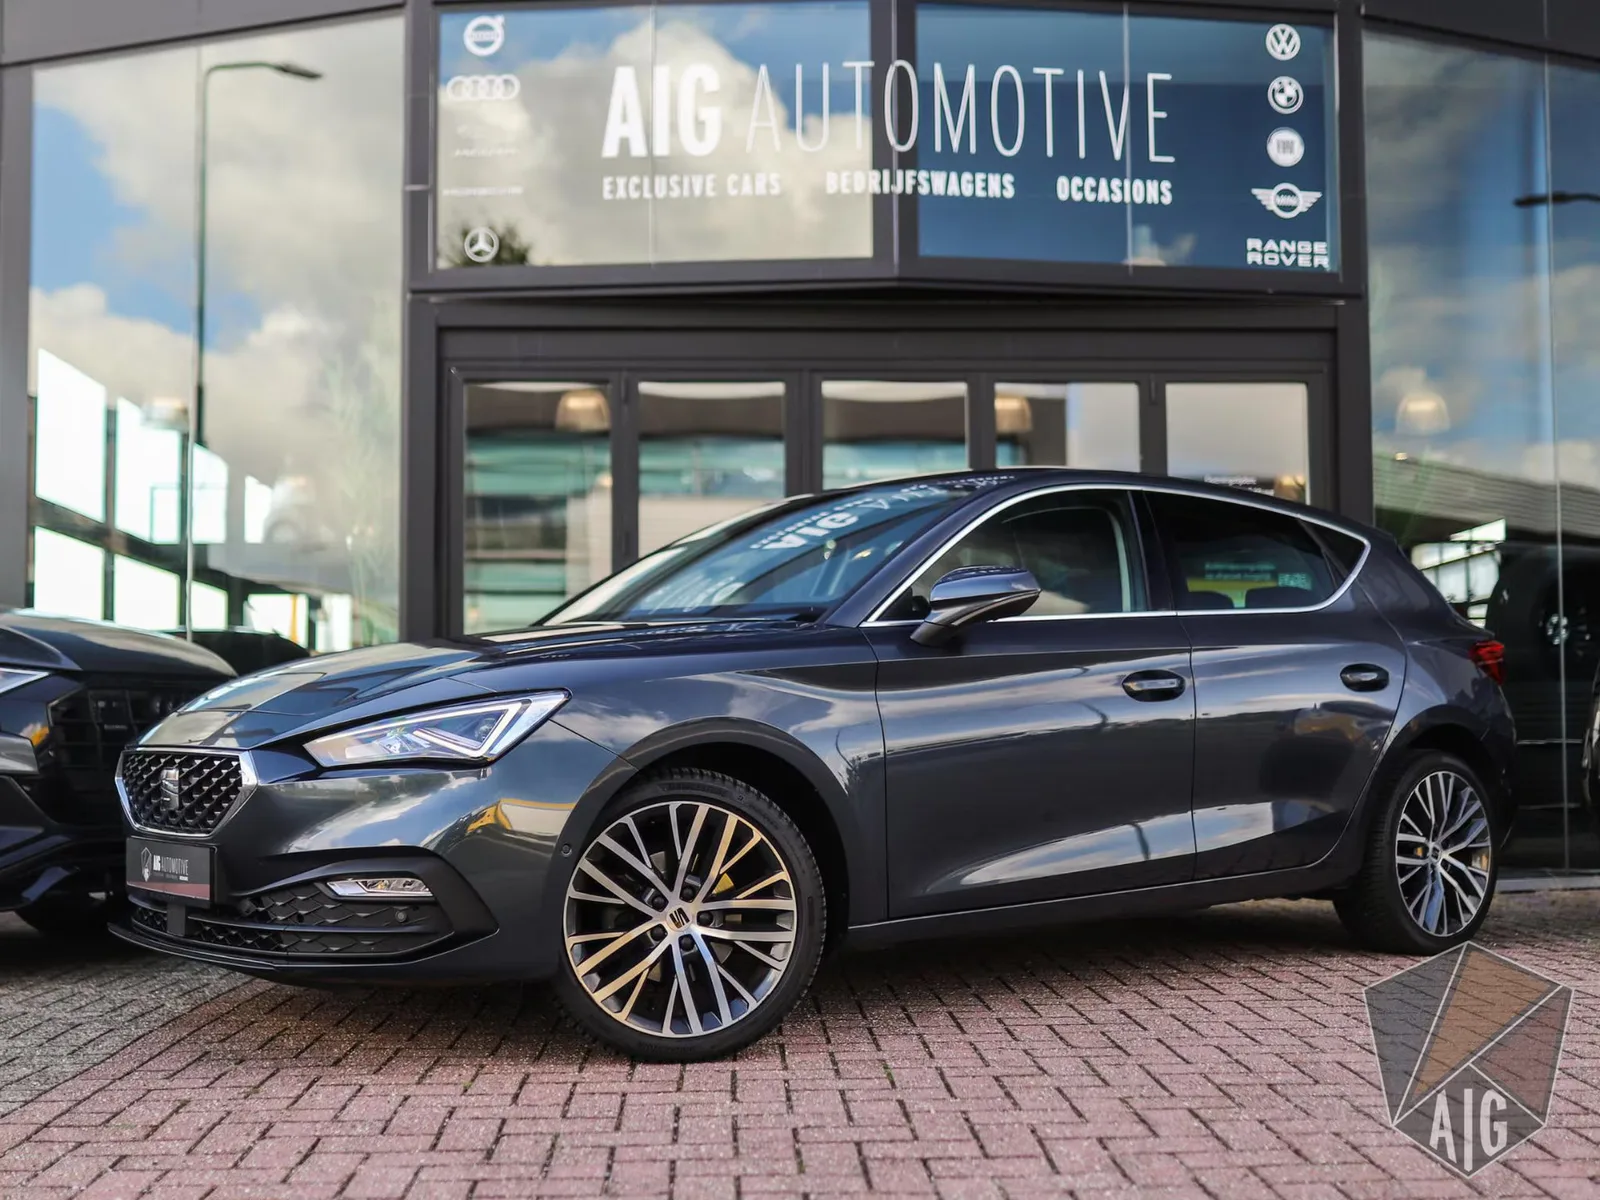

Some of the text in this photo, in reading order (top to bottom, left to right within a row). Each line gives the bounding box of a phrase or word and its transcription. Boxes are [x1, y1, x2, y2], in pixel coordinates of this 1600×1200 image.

[601, 60, 1176, 163] AIG AUTOMOTIVE
[602, 169, 1173, 205] EXCLUSIVE CARS BEDRIJFSWAGENS OCCASIONS
[1246, 238, 1328, 255] RANGE
[1246, 251, 1330, 269] ROVER
